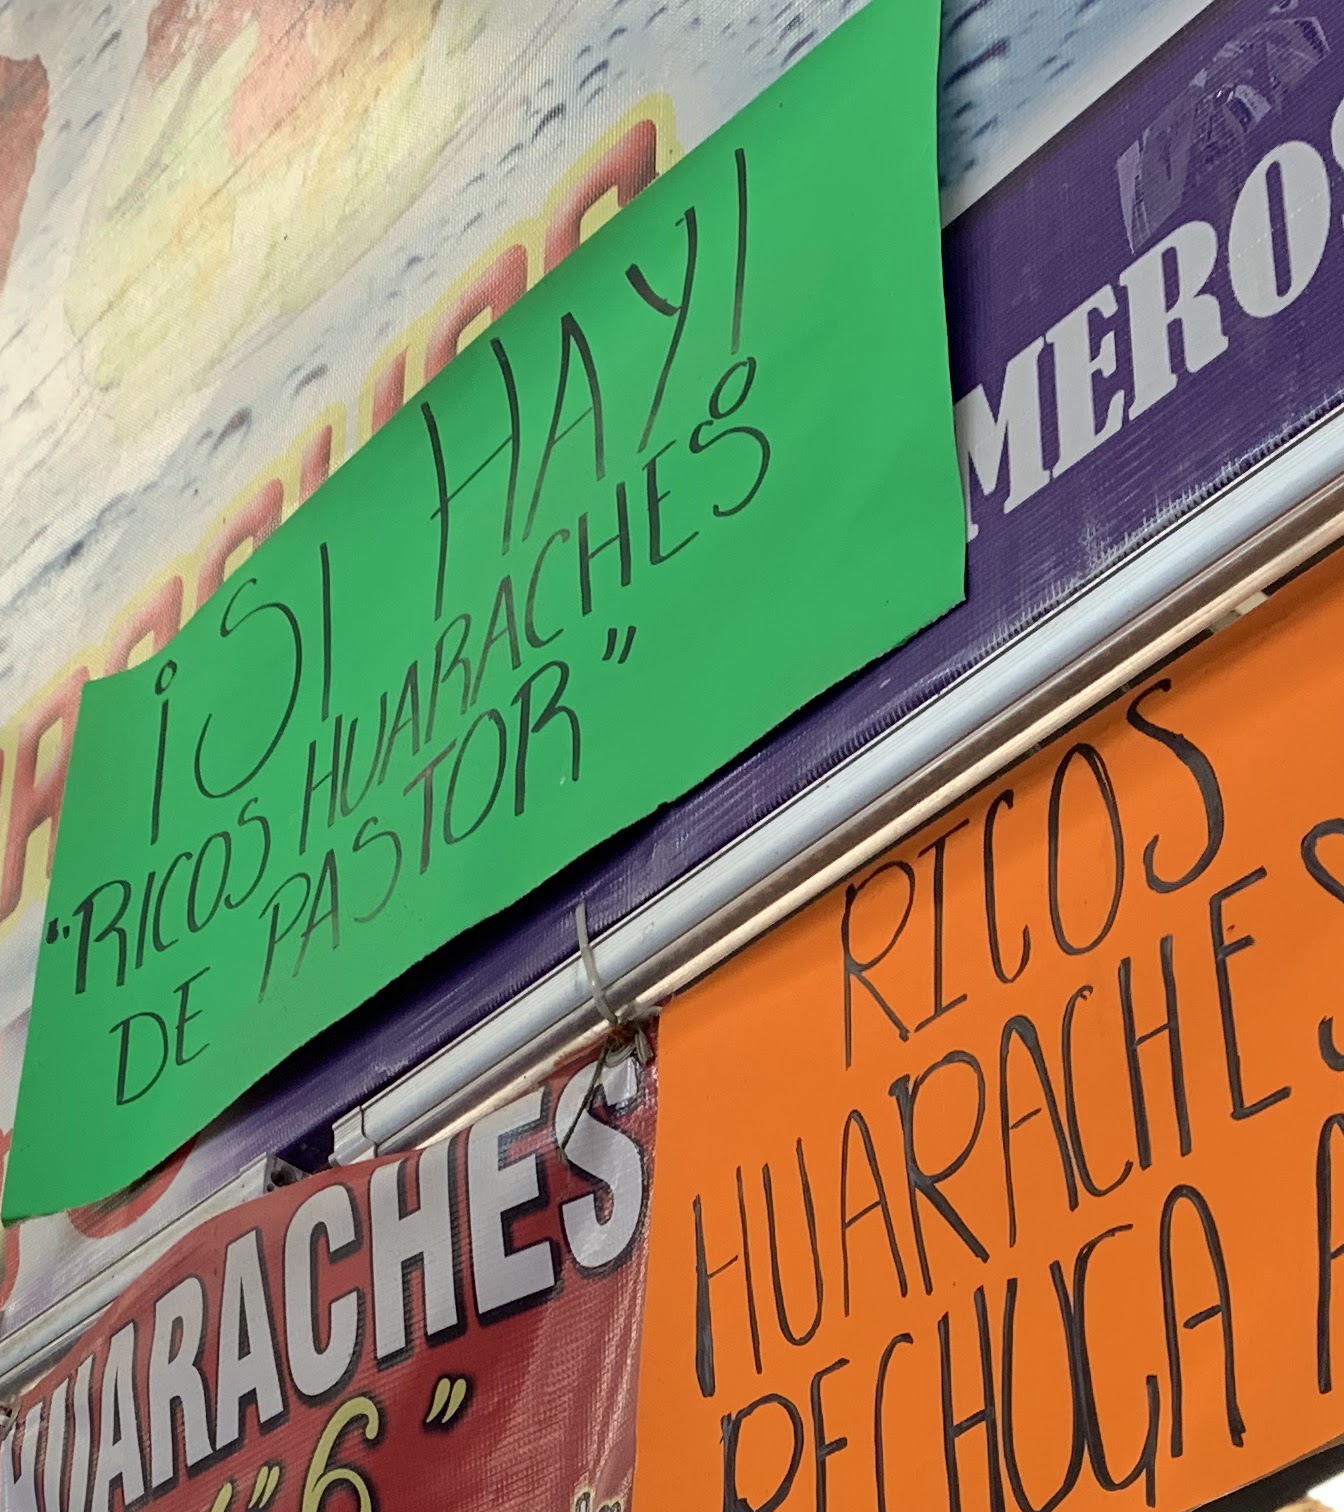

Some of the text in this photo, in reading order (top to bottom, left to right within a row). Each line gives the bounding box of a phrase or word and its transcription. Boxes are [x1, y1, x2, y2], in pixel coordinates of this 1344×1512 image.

[298, 419, 772, 857] HUARACHES
[110, 966, 212, 1107] DE
[257, 624, 638, 1004] PASTOR"
[843, 678, 1228, 1071] RICOS
